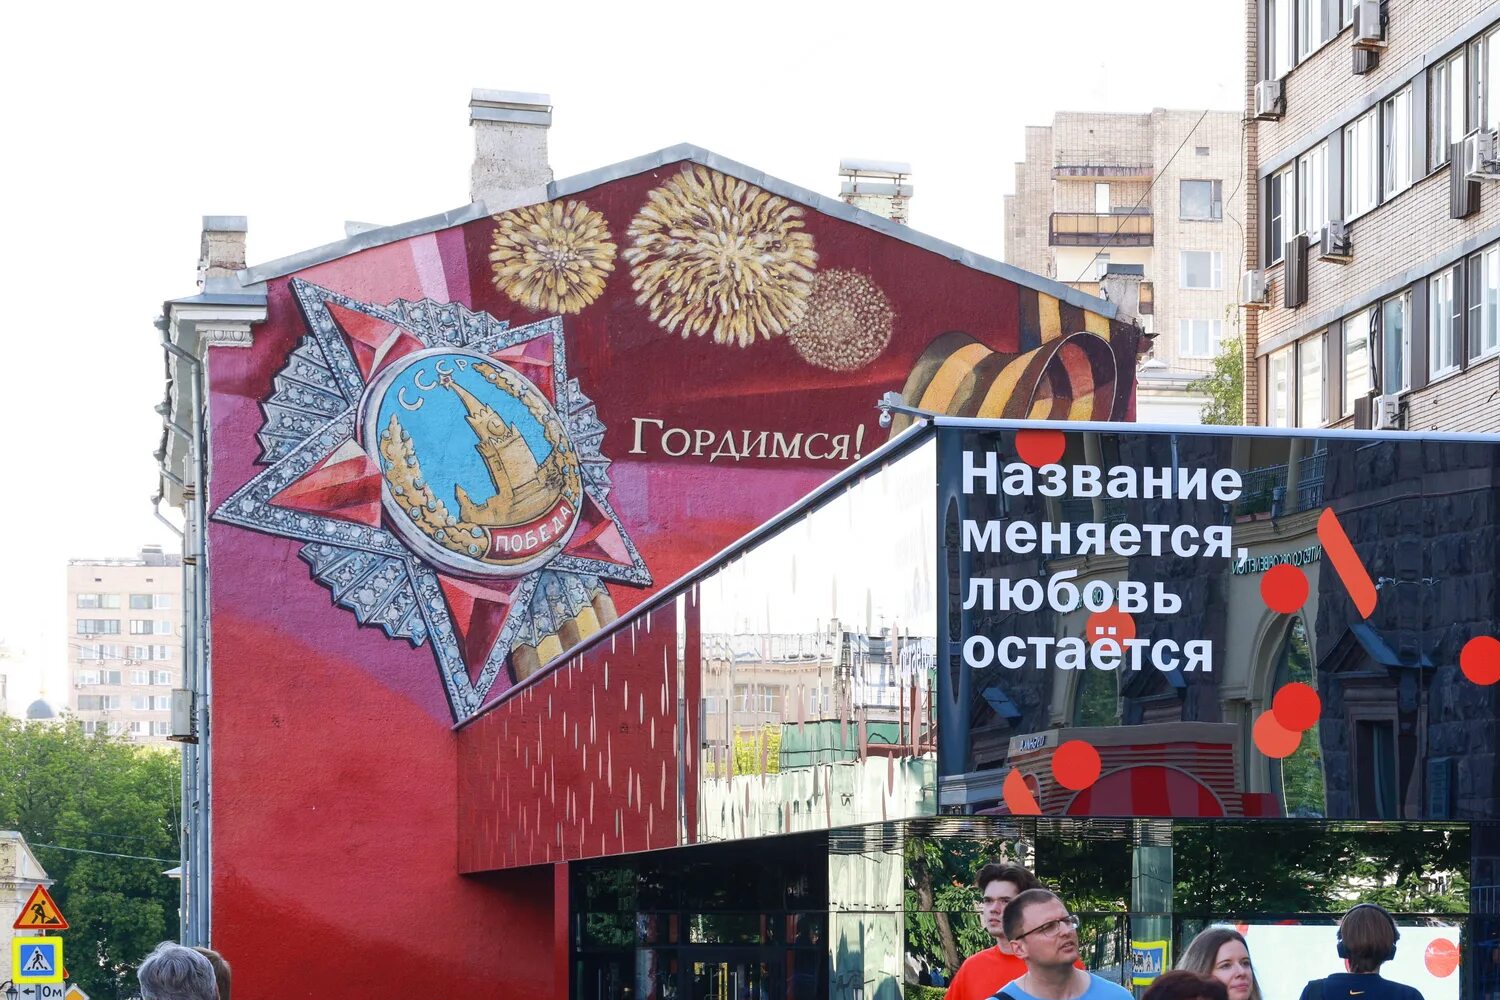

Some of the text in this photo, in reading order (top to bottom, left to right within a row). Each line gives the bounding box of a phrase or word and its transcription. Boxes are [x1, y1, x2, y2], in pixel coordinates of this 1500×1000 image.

[397, 359, 468, 411] СССР
[962, 450, 1243, 501] Название
[495, 505, 572, 553] ПОБЕДА
[962, 519, 1249, 568] меняется,
[962, 569, 1183, 614] любовь
[962, 626, 1213, 672] остаётся
